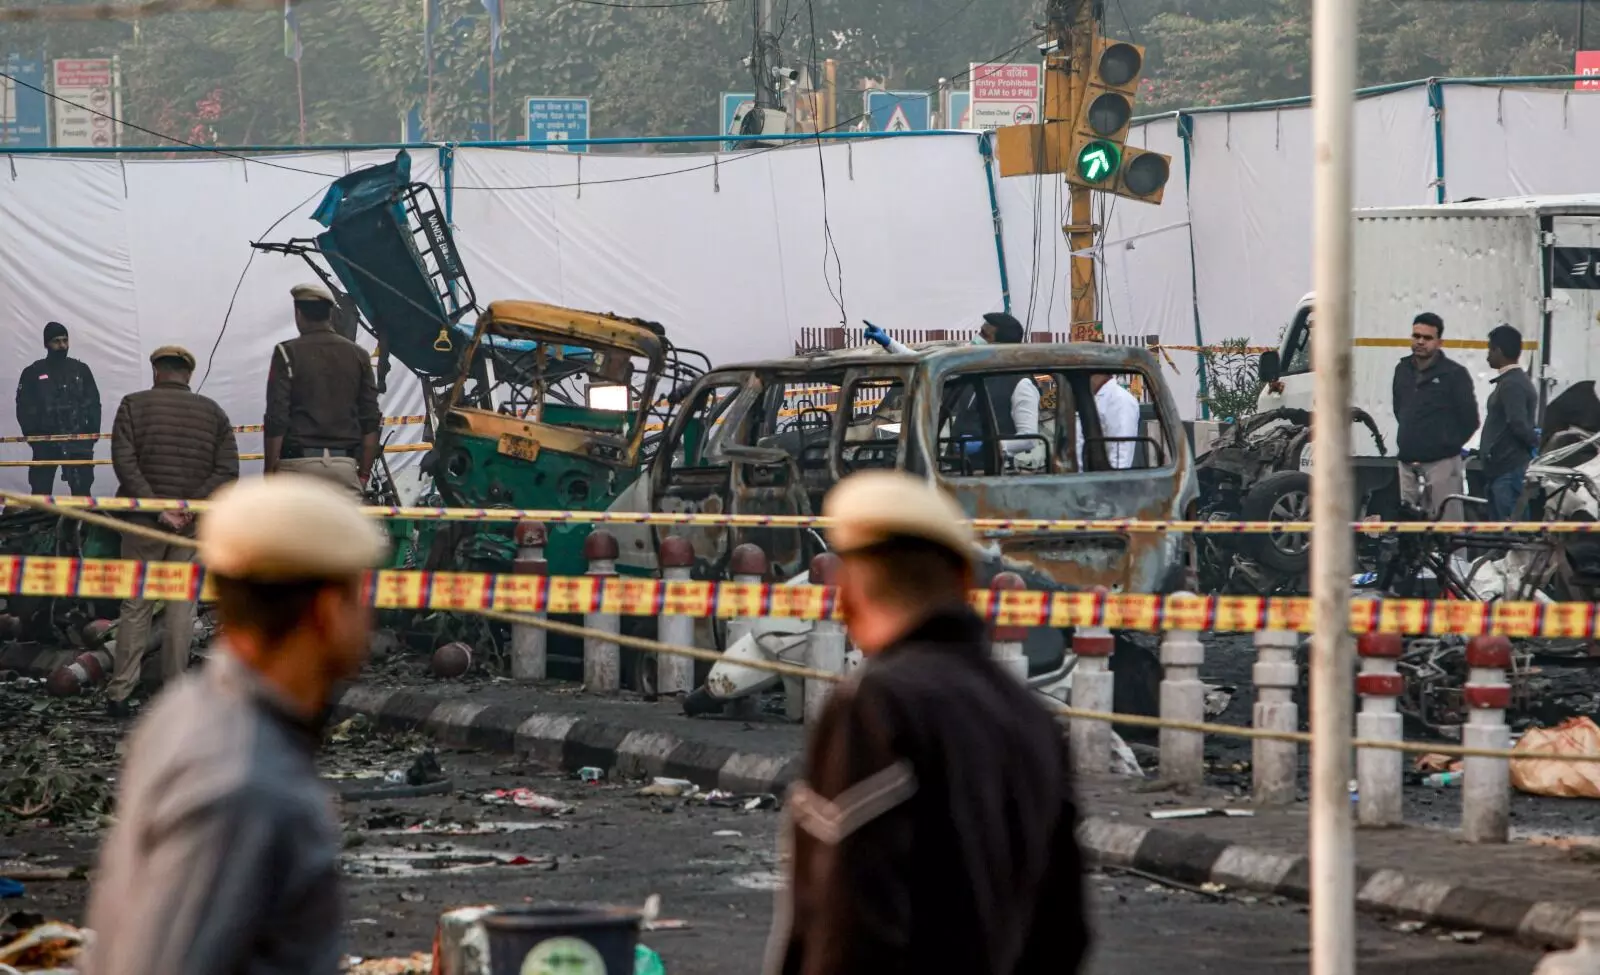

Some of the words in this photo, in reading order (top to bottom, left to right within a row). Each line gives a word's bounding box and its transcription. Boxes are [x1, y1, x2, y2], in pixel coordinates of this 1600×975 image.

[976, 80, 996, 88] Entry
[998, 79, 1036, 87] Prohibited
[428, 214, 445, 242] VANDE
